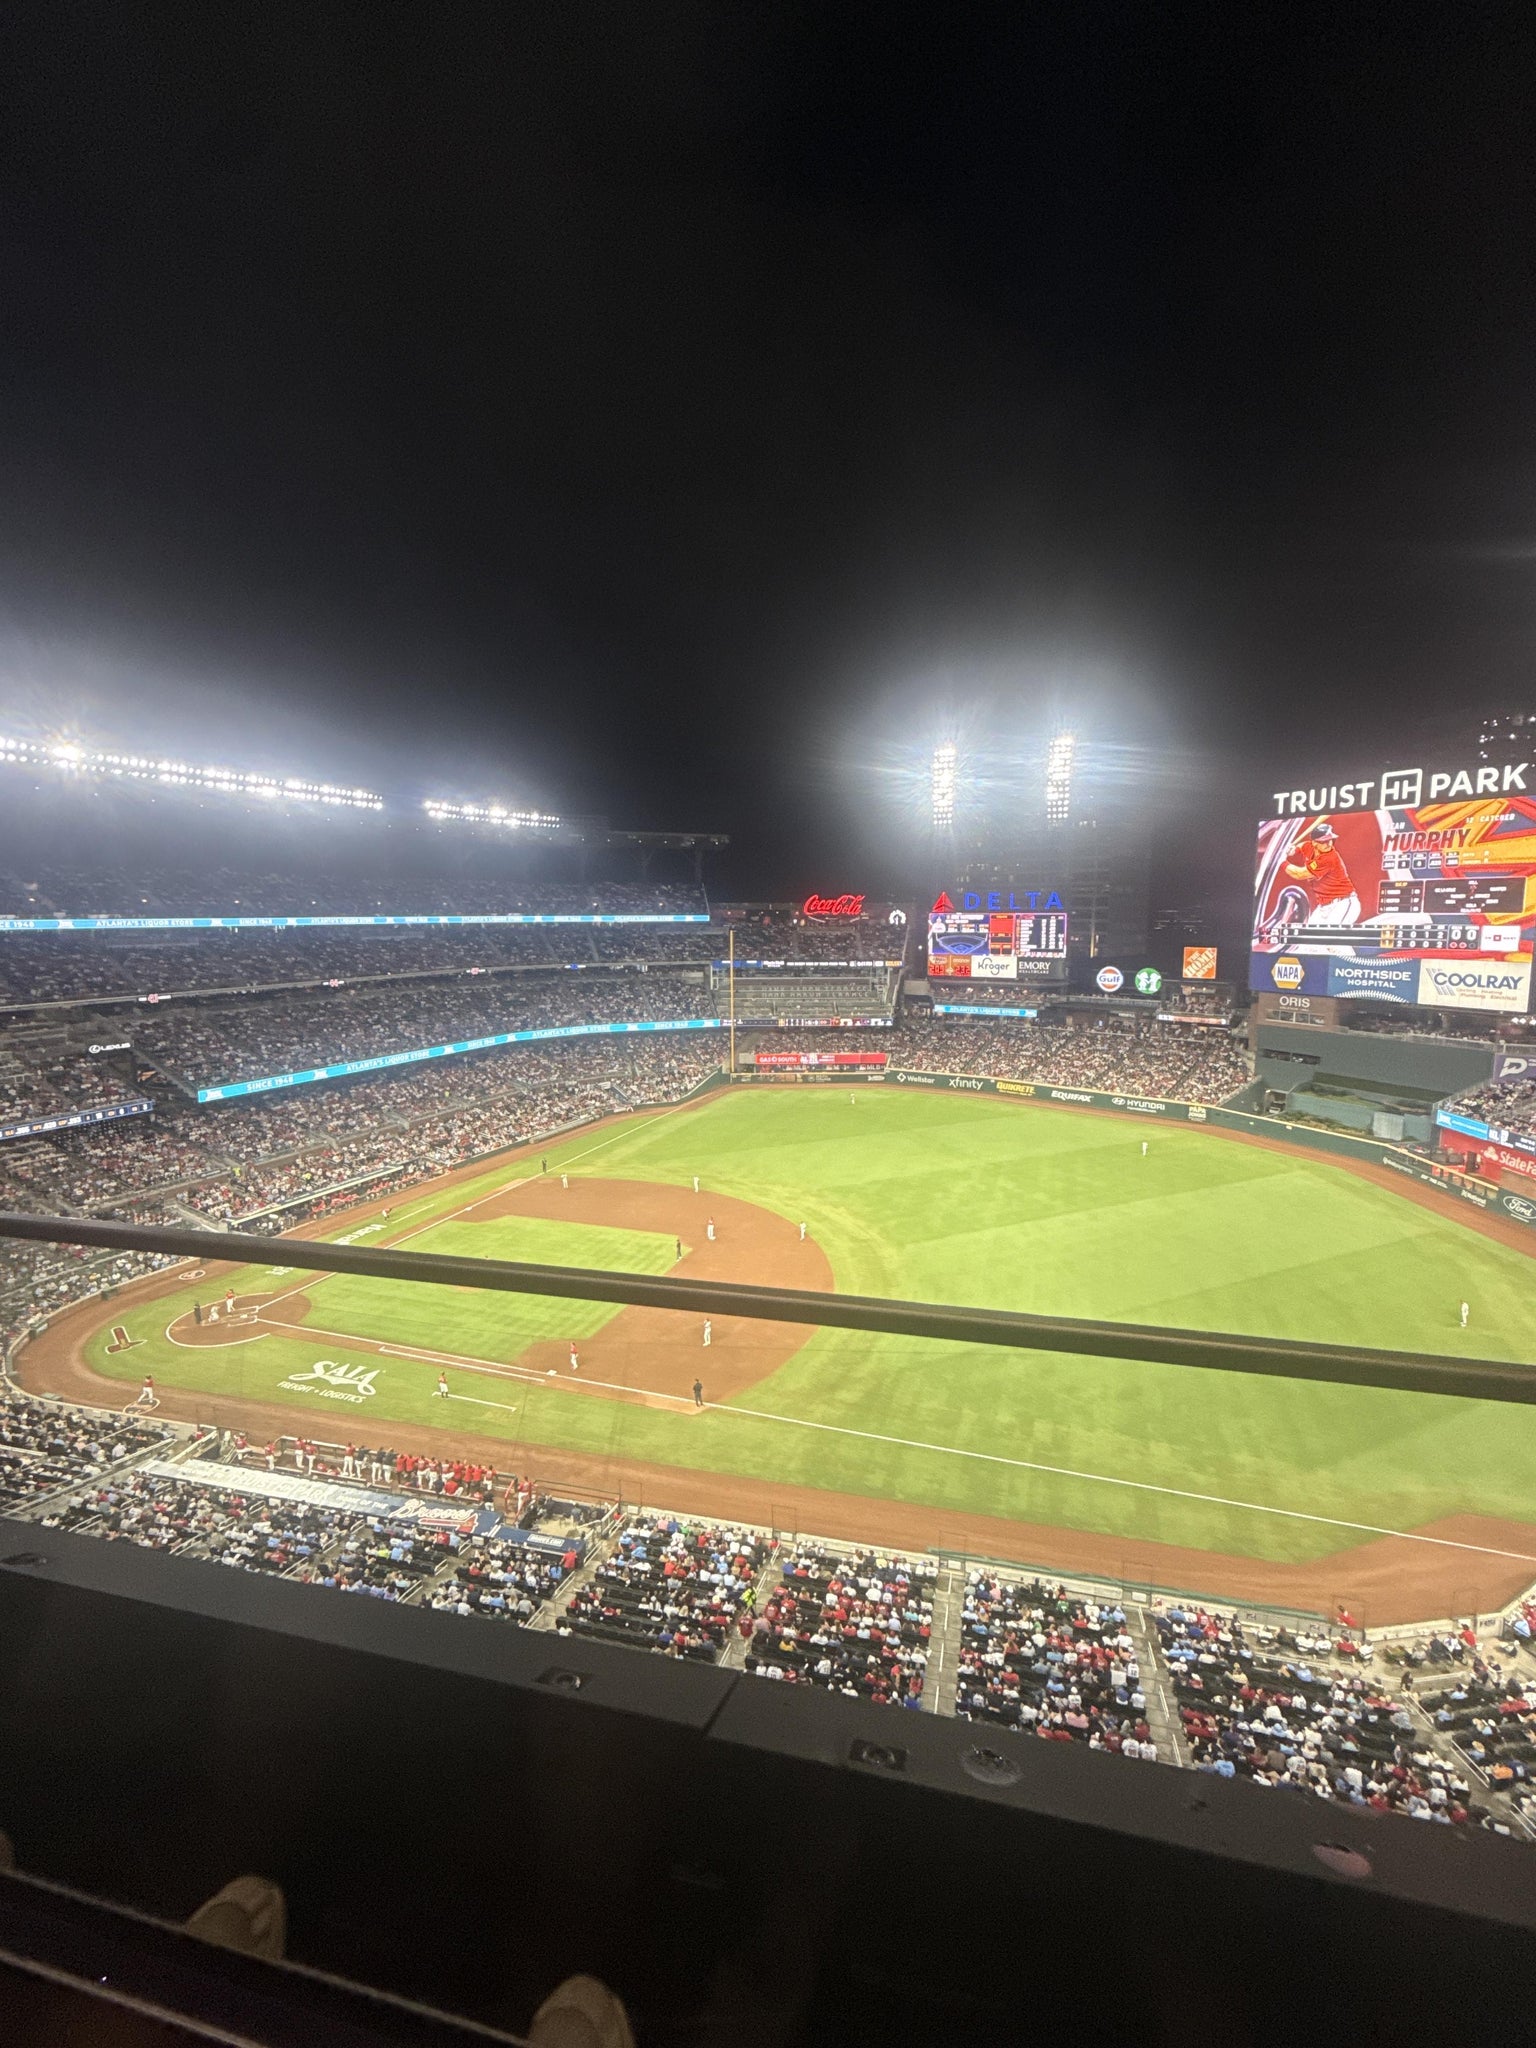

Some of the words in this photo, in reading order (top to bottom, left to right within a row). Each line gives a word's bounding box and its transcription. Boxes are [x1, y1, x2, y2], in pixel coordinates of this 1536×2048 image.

[1273, 782, 1375, 815] TRUIST
[1430, 763, 1529, 799] PARK
[1383, 829, 1471, 852] MURPHY
[964, 891, 1064, 911] DELTA
[1397, 930, 1404, 939] 2
[1410, 930, 1417, 939] 0
[1424, 930, 1430, 939] 1
[1437, 931, 1444, 939] 2
[1451, 929, 1461, 940] 0
[1466, 929, 1477, 941] 0
[1396, 940, 1403, 948] 2
[1409, 940, 1416, 948] 0
[1422, 940, 1430, 948] 0
[1436, 941, 1444, 949] 2
[977, 957, 1011, 976] Kroger
[1018, 961, 1052, 971] EMORY
[1184, 948, 1214, 977] HOME
[1098, 974, 1121, 983] Gulf
[1277, 965, 1299, 980] NAPA
[1335, 968, 1412, 981] NORTHSIDE
[1347, 979, 1396, 989] HOSPITAL
[1434, 971, 1524, 990] COOLRAY
[1279, 995, 1311, 1008] ORIS
[101, 1042, 131, 1051] LEXUS
[346, 1058, 384, 1073] ATLANTA'S
[384, 1055, 409, 1065] LIQUOR
[759, 1056, 772, 1064] GAS
[777, 1056, 798, 1064] SOUTH
[247, 1080, 273, 1092] SINCE
[274, 1076, 294, 1087] 1948
[907, 1075, 935, 1085] Wellstar
[948, 1077, 983, 1091] xfinity
[996, 1081, 1035, 1094] QUIKRETE
[1051, 1090, 1091, 1103] EQUIFAX
[1127, 1099, 1165, 1111] HYUNDAI
[1188, 1106, 1206, 1114] PAPA
[1508, 1198, 1533, 1217] Ford
[288, 1360, 381, 1396] SAIA
[277, 1381, 315, 1393] FREIGHT
[319, 1389, 367, 1404] LOGISTICS
[389, 1498, 474, 1519] Braves
